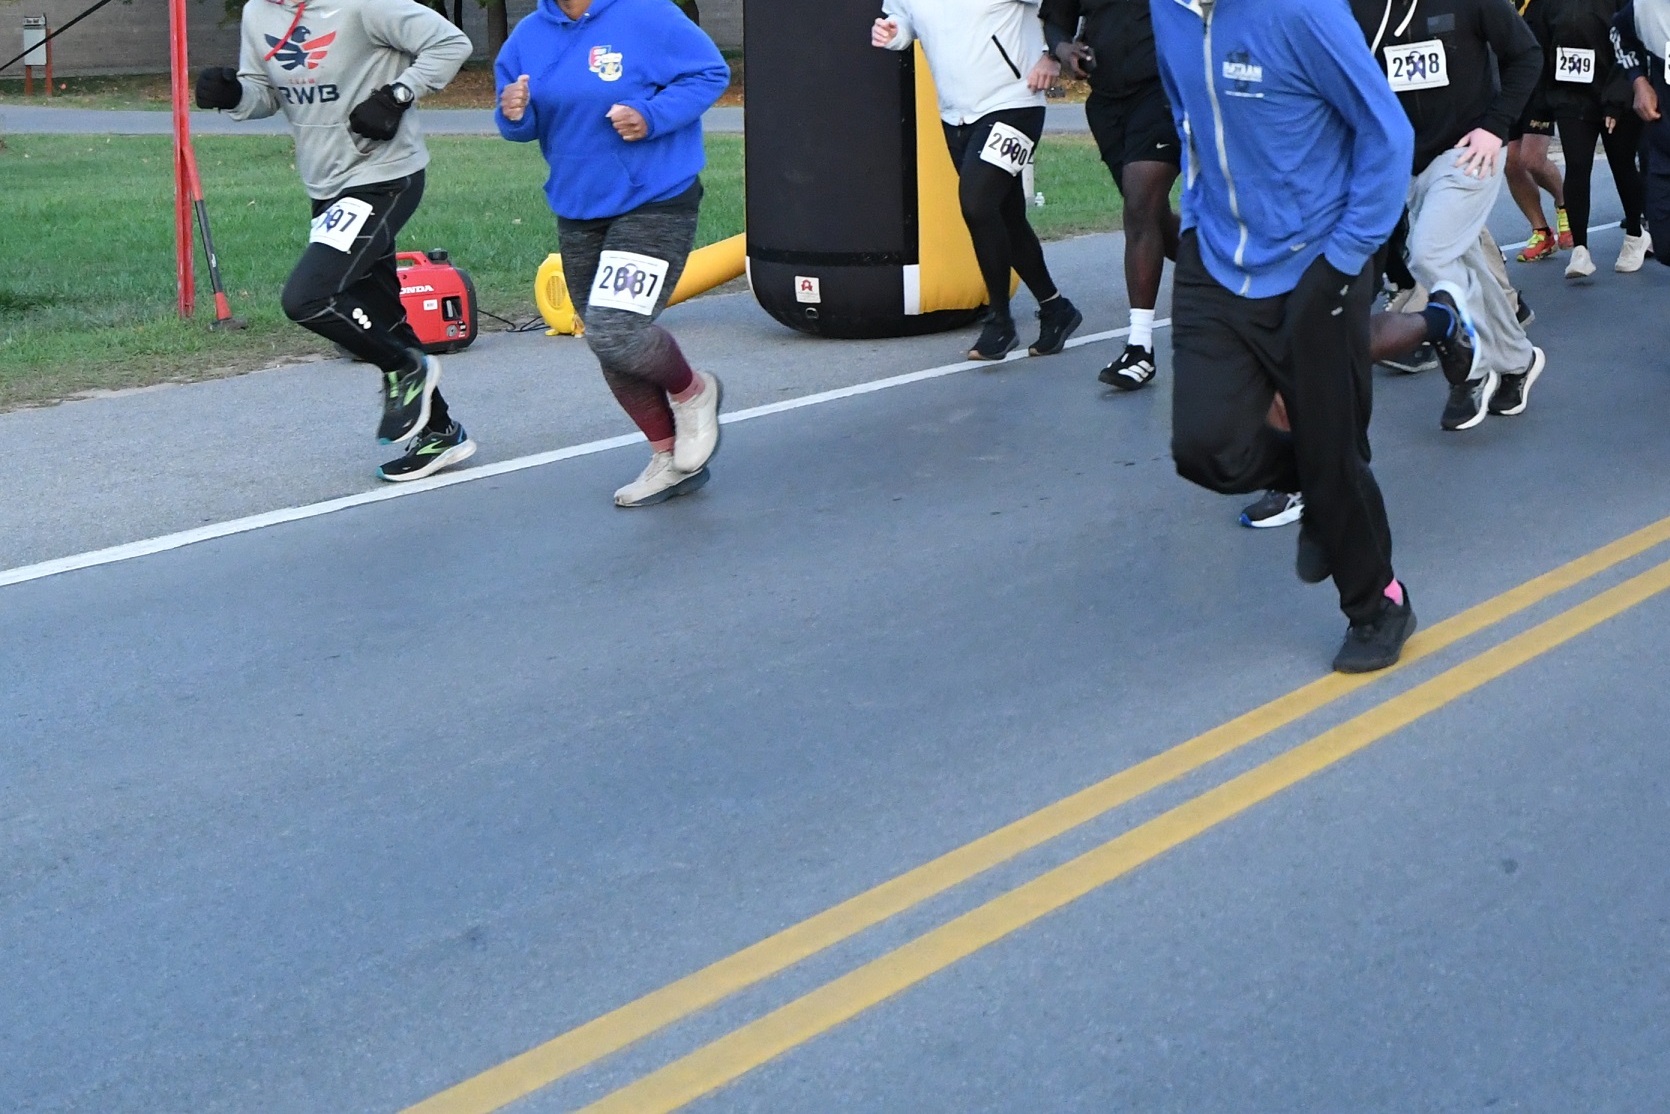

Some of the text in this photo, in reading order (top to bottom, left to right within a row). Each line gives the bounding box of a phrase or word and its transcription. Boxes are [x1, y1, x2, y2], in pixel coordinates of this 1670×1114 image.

[1392, 52, 1440, 78] 2518
[1560, 56, 1590, 73] 2519
[599, 265, 659, 298] 2687
